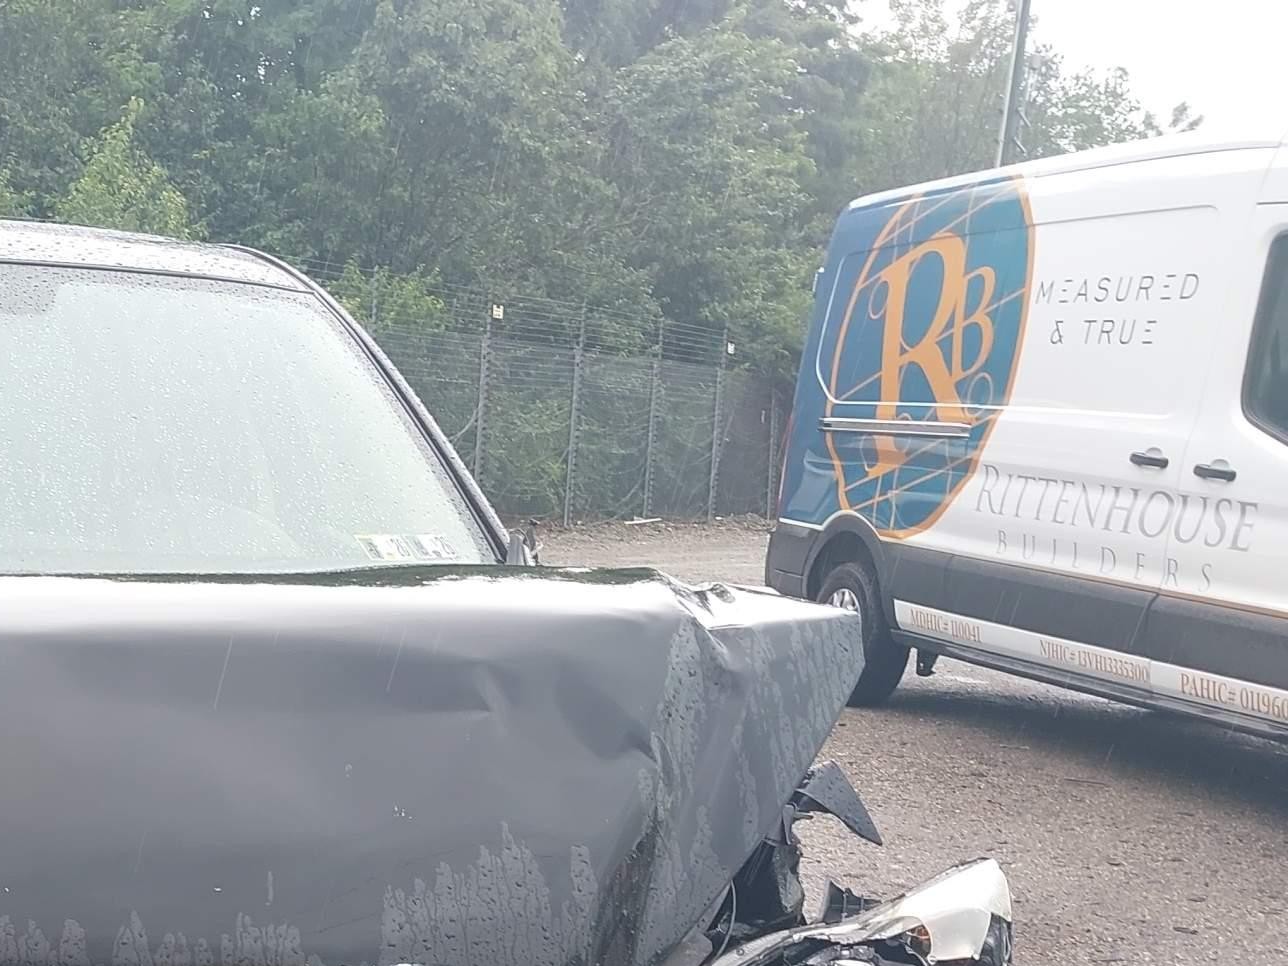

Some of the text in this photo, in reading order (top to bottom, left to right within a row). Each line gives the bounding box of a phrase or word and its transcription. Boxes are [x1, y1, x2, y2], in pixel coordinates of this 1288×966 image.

[1035, 273, 1200, 305] MEASURED
[1049, 319, 1158, 345] & TRUE
[974, 463, 1260, 552] RITTENHOUSE
[995, 529, 1213, 593] BUILDERS
[1179, 672, 1236, 705] PAHIC=
